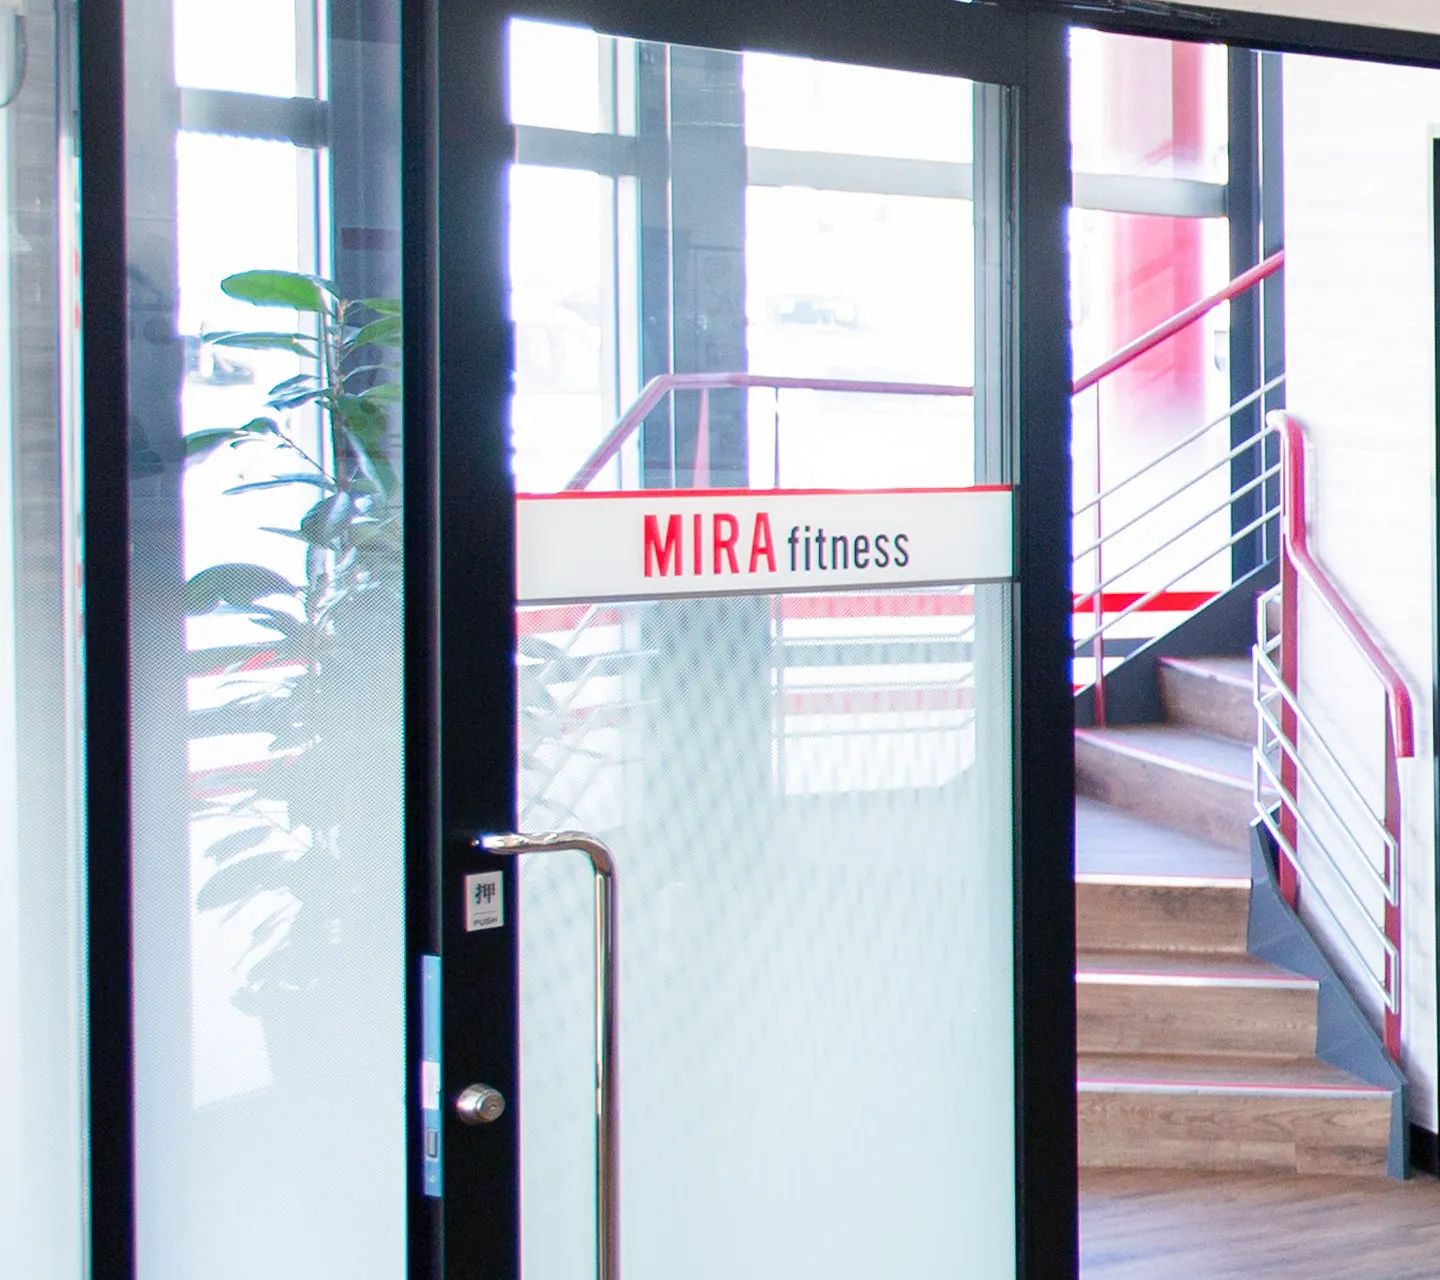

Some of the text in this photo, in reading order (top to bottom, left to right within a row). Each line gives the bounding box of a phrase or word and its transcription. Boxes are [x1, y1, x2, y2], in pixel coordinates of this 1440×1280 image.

[644, 512, 910, 578] MIRA fitness
[474, 882, 496, 904] 押
